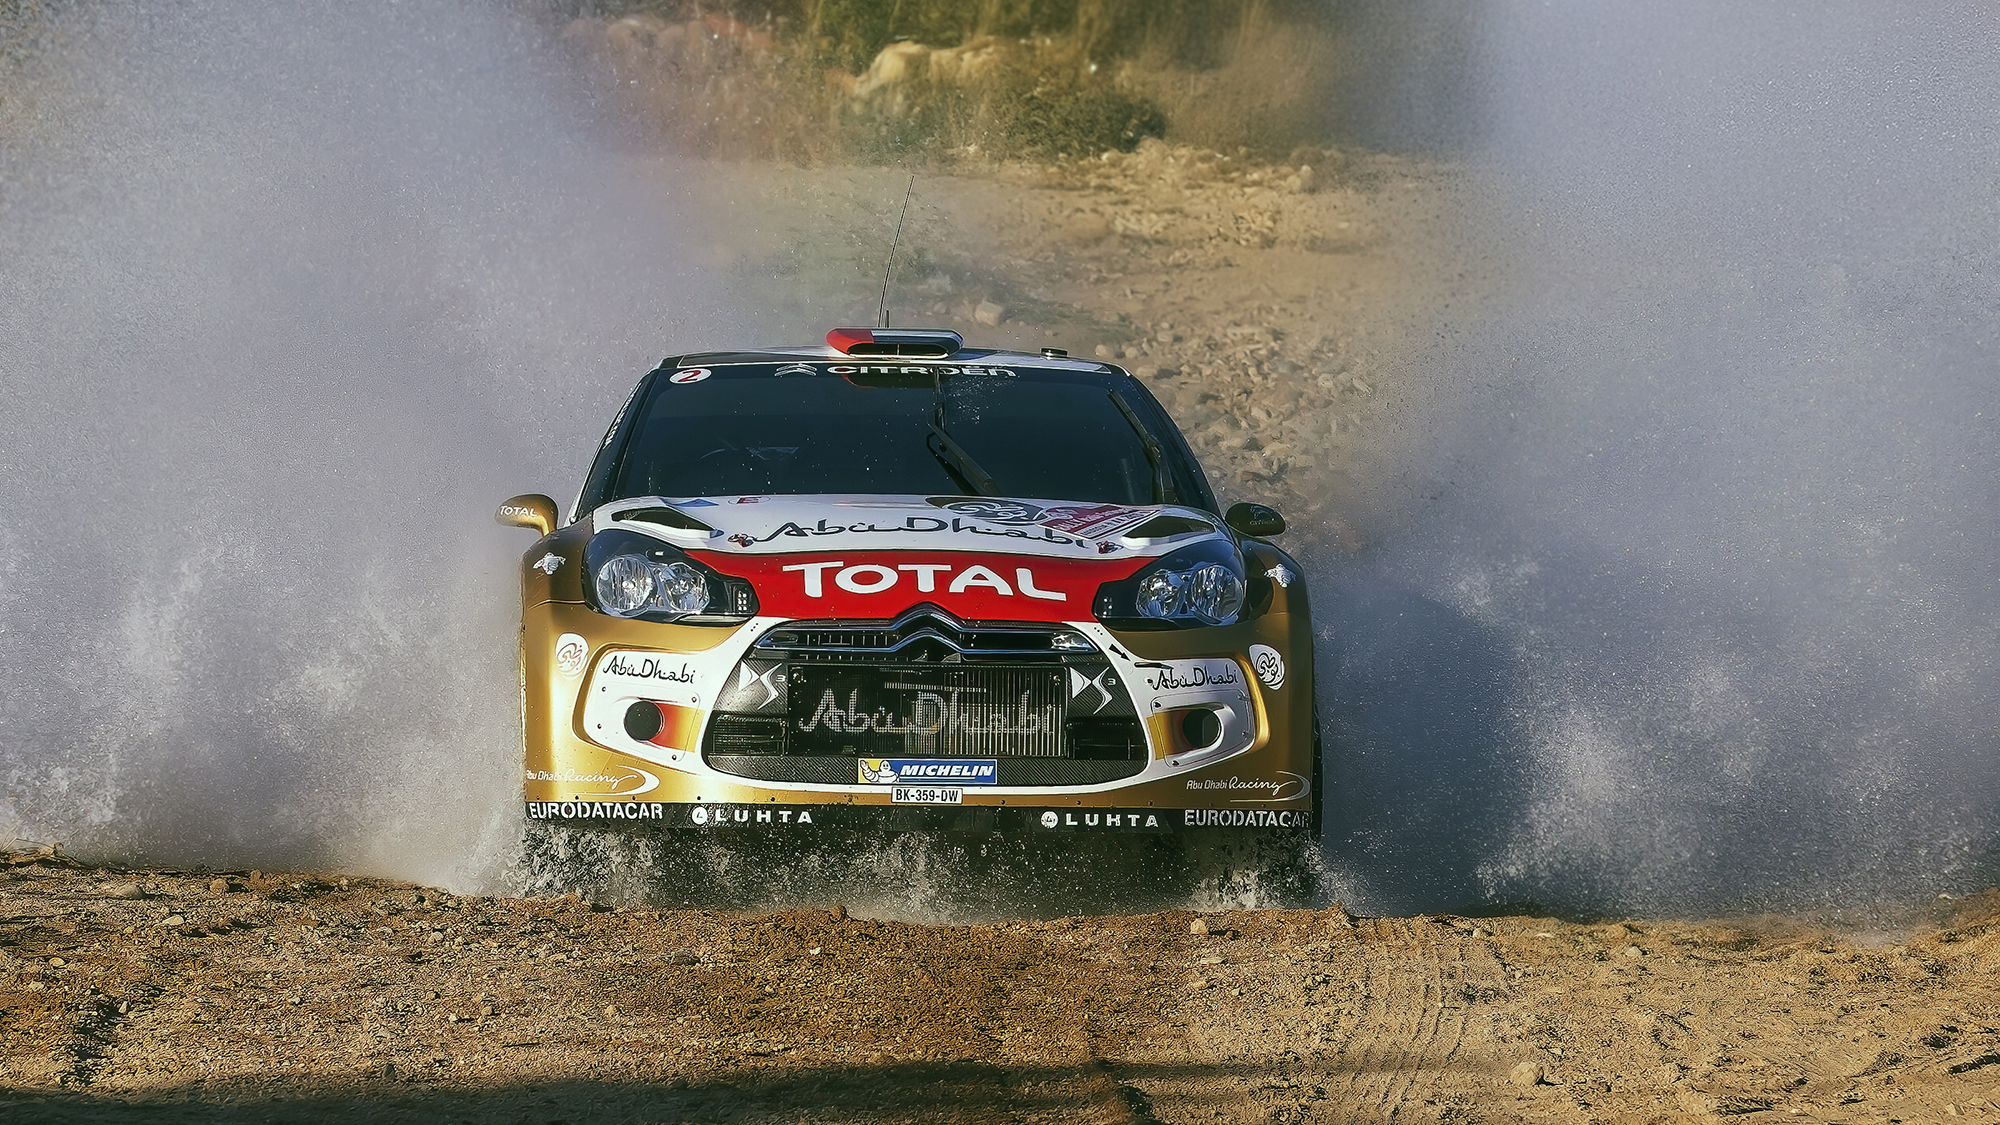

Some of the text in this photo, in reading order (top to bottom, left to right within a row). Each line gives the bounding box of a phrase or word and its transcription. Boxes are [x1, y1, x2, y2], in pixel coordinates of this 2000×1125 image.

[678, 370, 702, 383] 2
[500, 505, 538, 517] TOTAL
[782, 561, 1067, 601] TOTAL
[639, 658, 696, 684] Dhabi
[1193, 665, 1238, 687] Dhabi
[900, 765, 993, 776] MICHELIN
[565, 769, 638, 790] Racing
[1186, 776, 1297, 796] Abu Dhabi Racing
[896, 789, 958, 802] BK-359-DW
[529, 802, 663, 819] EURODATACAR
[715, 808, 812, 823] LUHTA
[1184, 809, 1310, 828] EURODATACAR
[1065, 813, 1158, 827] LUHTA
